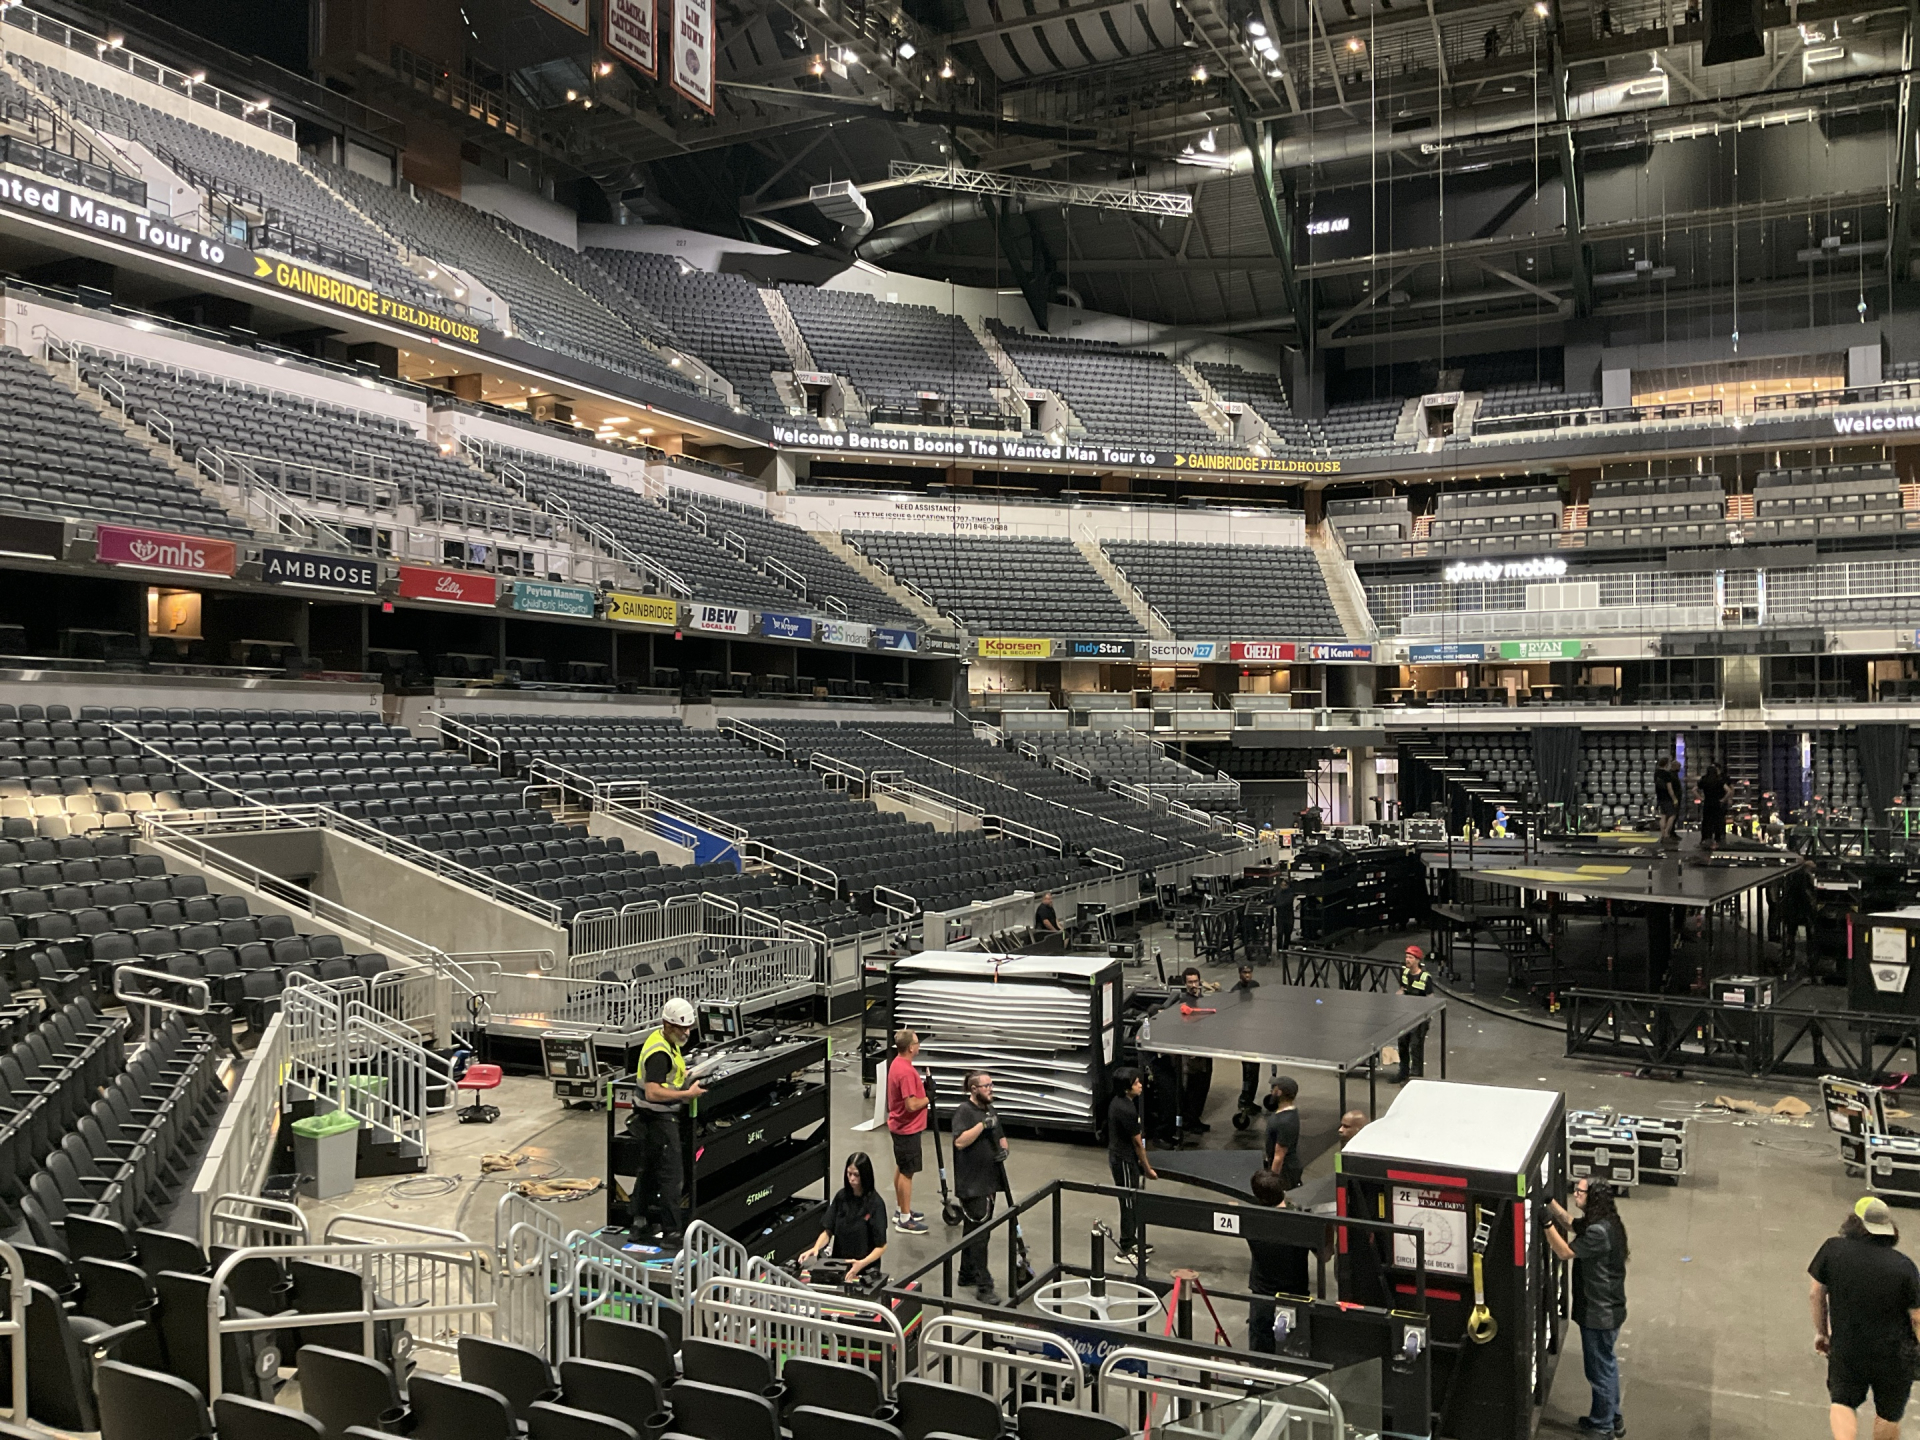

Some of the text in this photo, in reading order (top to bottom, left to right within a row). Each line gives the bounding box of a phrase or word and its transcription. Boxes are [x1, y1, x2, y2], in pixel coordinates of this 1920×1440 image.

[685, 5, 700, 28] LIN
[611, 9, 650, 48] CATCHINGS
[681, 20, 704, 49] DUNN
[70, 195, 127, 234] Man
[136, 216, 192, 253] Tour
[200, 241, 225, 264] to
[1331, 217, 1349, 233] AM
[276, 263, 479, 344] GAINBRIDGE FIELDHOUSE
[772, 425, 1156, 465] Welcome Benson Boone The Wanted Man Tour to
[1188, 453, 1341, 473] GAINBRIDGE FIELDHOUSE
[914, 504, 961, 513] ASSISTANCE?
[159, 542, 206, 569] mhs
[268, 558, 373, 586] AMBROSE
[1445, 557, 1568, 583] xfinity mobile
[434, 576, 463, 599] Lilly
[526, 585, 584, 603] Peyton Manning
[622, 601, 674, 621] GAINBRIDGE
[701, 606, 739, 625] IBEW
[701, 622, 737, 632] LOCAL 481
[780, 617, 799, 637] Kroger
[823, 623, 844, 642] aes
[845, 631, 867, 645] Indiana
[985, 640, 1042, 651] Koorsen
[1074, 643, 1126, 656] IndyStar.
[1151, 646, 1210, 656] SECTION 127
[1330, 648, 1371, 659] KennMar
[1528, 642, 1563, 652] RYAN
[1400, 1190, 1411, 1202] 2E
[1220, 1216, 1233, 1229] 2A
[1423, 1259, 1434, 1267] AGE
[1436, 1261, 1455, 1270] DECKS
